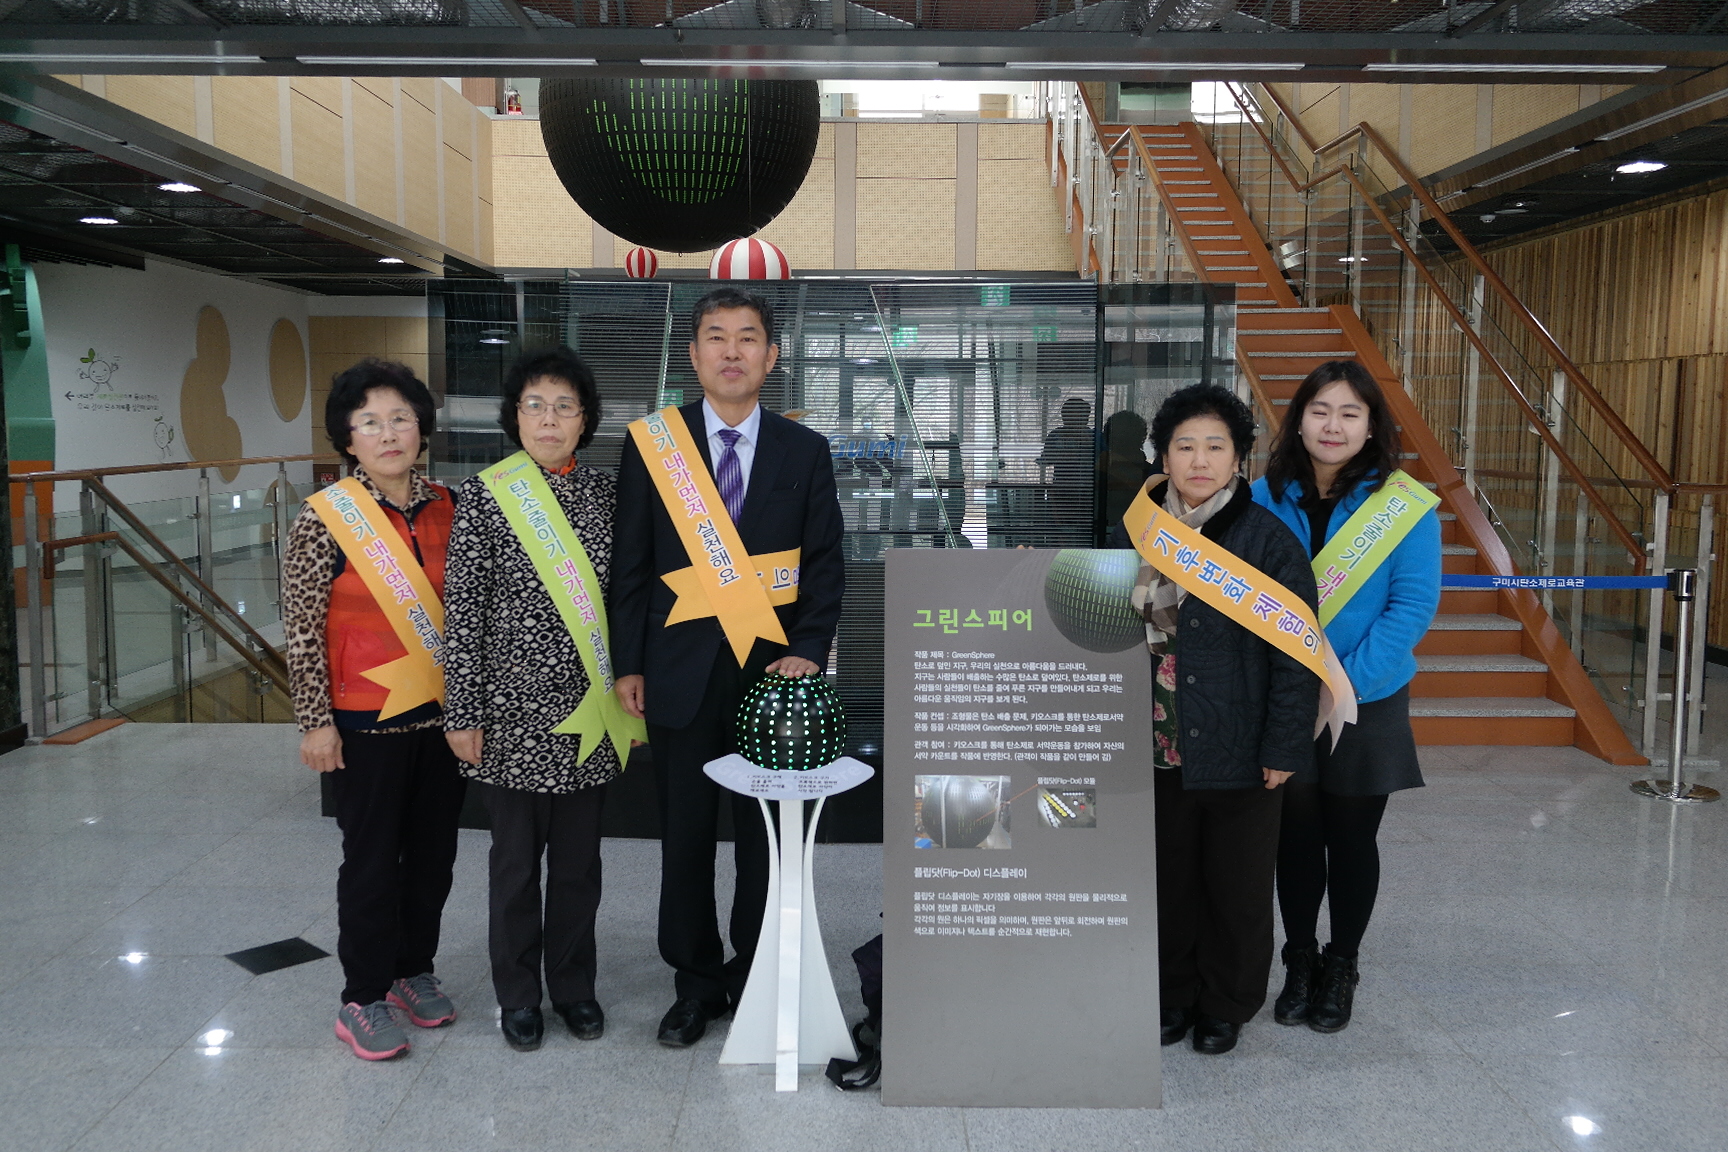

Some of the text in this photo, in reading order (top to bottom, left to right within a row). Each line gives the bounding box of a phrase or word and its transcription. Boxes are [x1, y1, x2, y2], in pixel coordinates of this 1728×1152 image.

[322, 484, 447, 667] 소줄이기 내가먼저 실천해요
[664, 451, 709, 518] 내가먼저
[696, 518, 740, 587] 실천해요
[1316, 495, 1409, 606] 탄소줄이기 내가
[1491, 577, 1586, 588] 구미시탄소제로교육관
[508, 478, 615, 695] 탄소줄이기 내가먼저 실천해요
[912, 608, 1033, 634] 그린스피어
[1152, 528, 1322, 655] 기후변화 체험의
